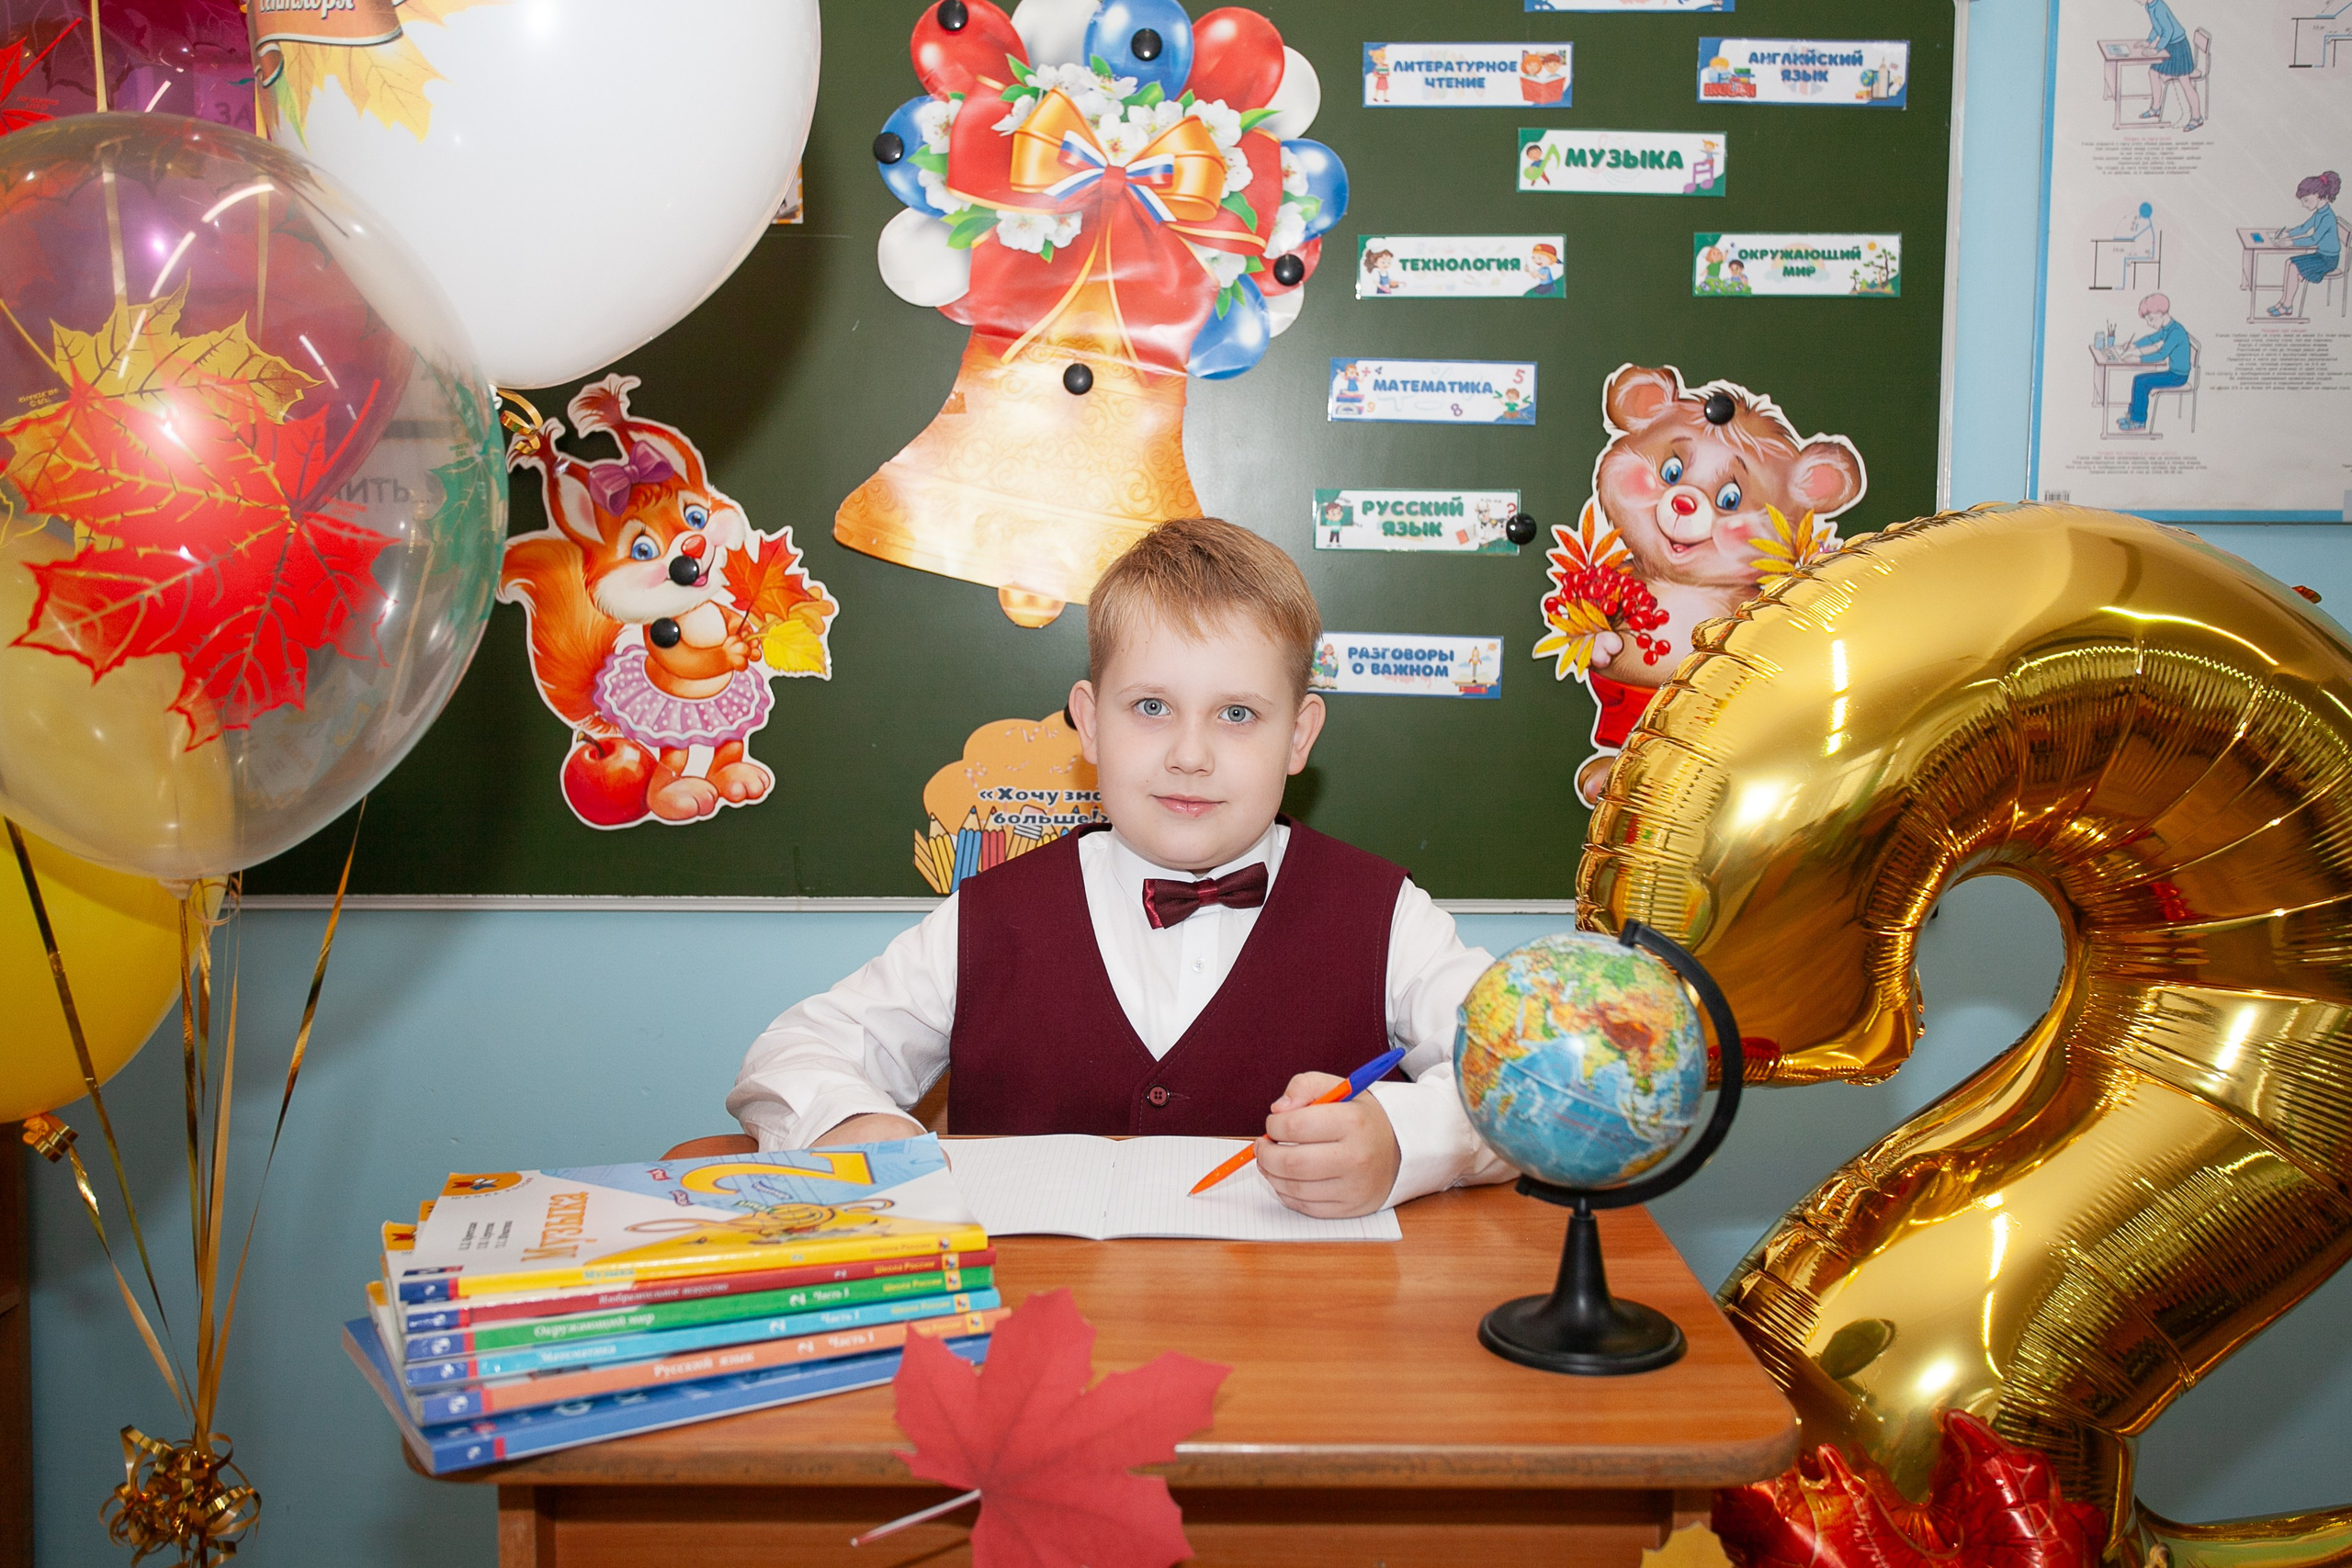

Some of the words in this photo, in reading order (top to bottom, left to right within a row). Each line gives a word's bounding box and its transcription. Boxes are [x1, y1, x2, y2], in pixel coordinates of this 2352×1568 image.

[1748, 50, 1863, 67] АНГЛИЙСКИЙ
[1394, 61, 1518, 73] ЛИТЕРАТУРНОЕ
[1425, 77, 1486, 88] ЧТЕНИЕ
[1781, 70, 1829, 83] ЯЗЫК
[1565, 148, 1684, 169] МУЗЫКА
[1737, 245, 1861, 261] ОКРУЖАЮЩИЙ
[1399, 257, 1521, 271] ТЕХНОЛОГИЯ
[1782, 265, 1816, 277] МИР
[1373, 379, 1494, 394] МАТЕМАТИКА
[1451, 403, 1463, 417] 8
[1362, 496, 1464, 517] РУССКИЙ
[1382, 521, 1442, 536] ЯЗЫК
[1348, 647, 1454, 661] РАЗГОВОРЫ
[1352, 662, 1364, 675] О
[1371, 663, 1449, 677] ВАЖНОМ
[979, 788, 1058, 806] «Хочу
[521, 1191, 598, 1262] Музыка
[534, 1316, 627, 1338] Окружающий
[653, 1355, 713, 1379] Русский
